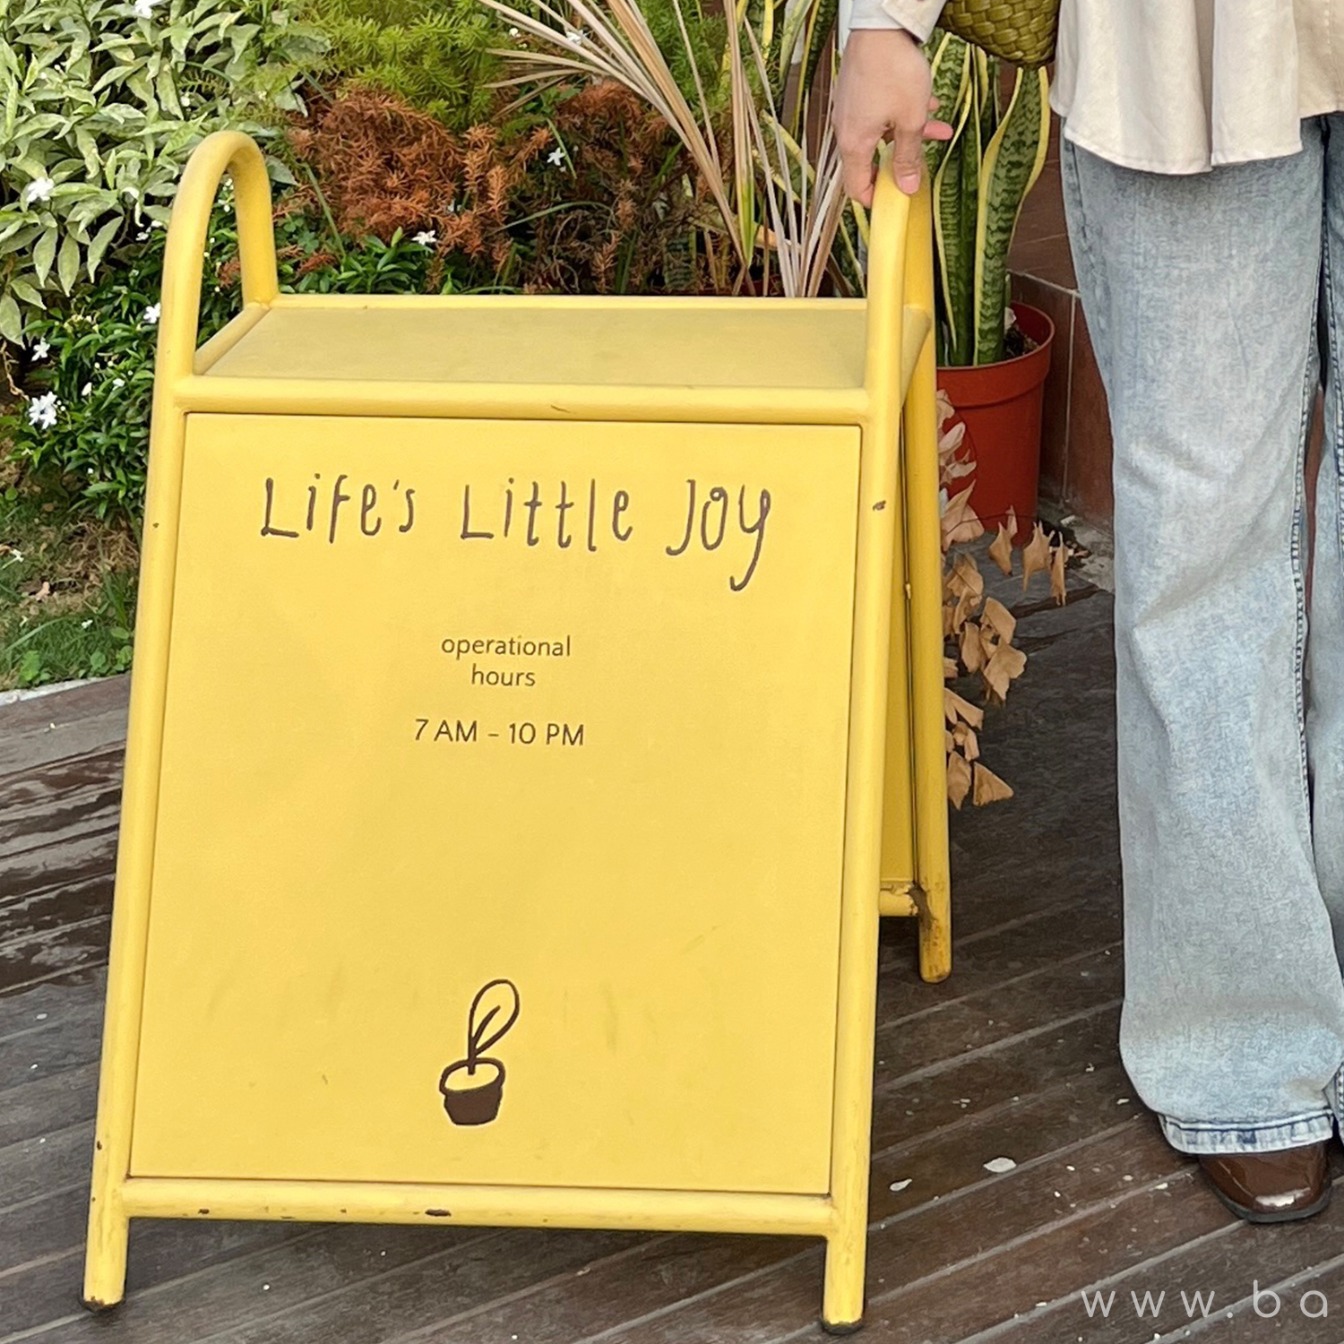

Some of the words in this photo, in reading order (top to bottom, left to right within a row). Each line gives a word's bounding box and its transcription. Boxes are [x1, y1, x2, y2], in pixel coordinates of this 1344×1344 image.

[261, 472, 416, 544] Life's
[459, 477, 633, 552] Little
[665, 478, 772, 592] Joy
[441, 635, 572, 660] operational
[470, 663, 536, 688] hours
[414, 718, 429, 743] 7
[434, 720, 479, 744] AM
[507, 722, 537, 746] 10
[546, 722, 585, 747] PM
